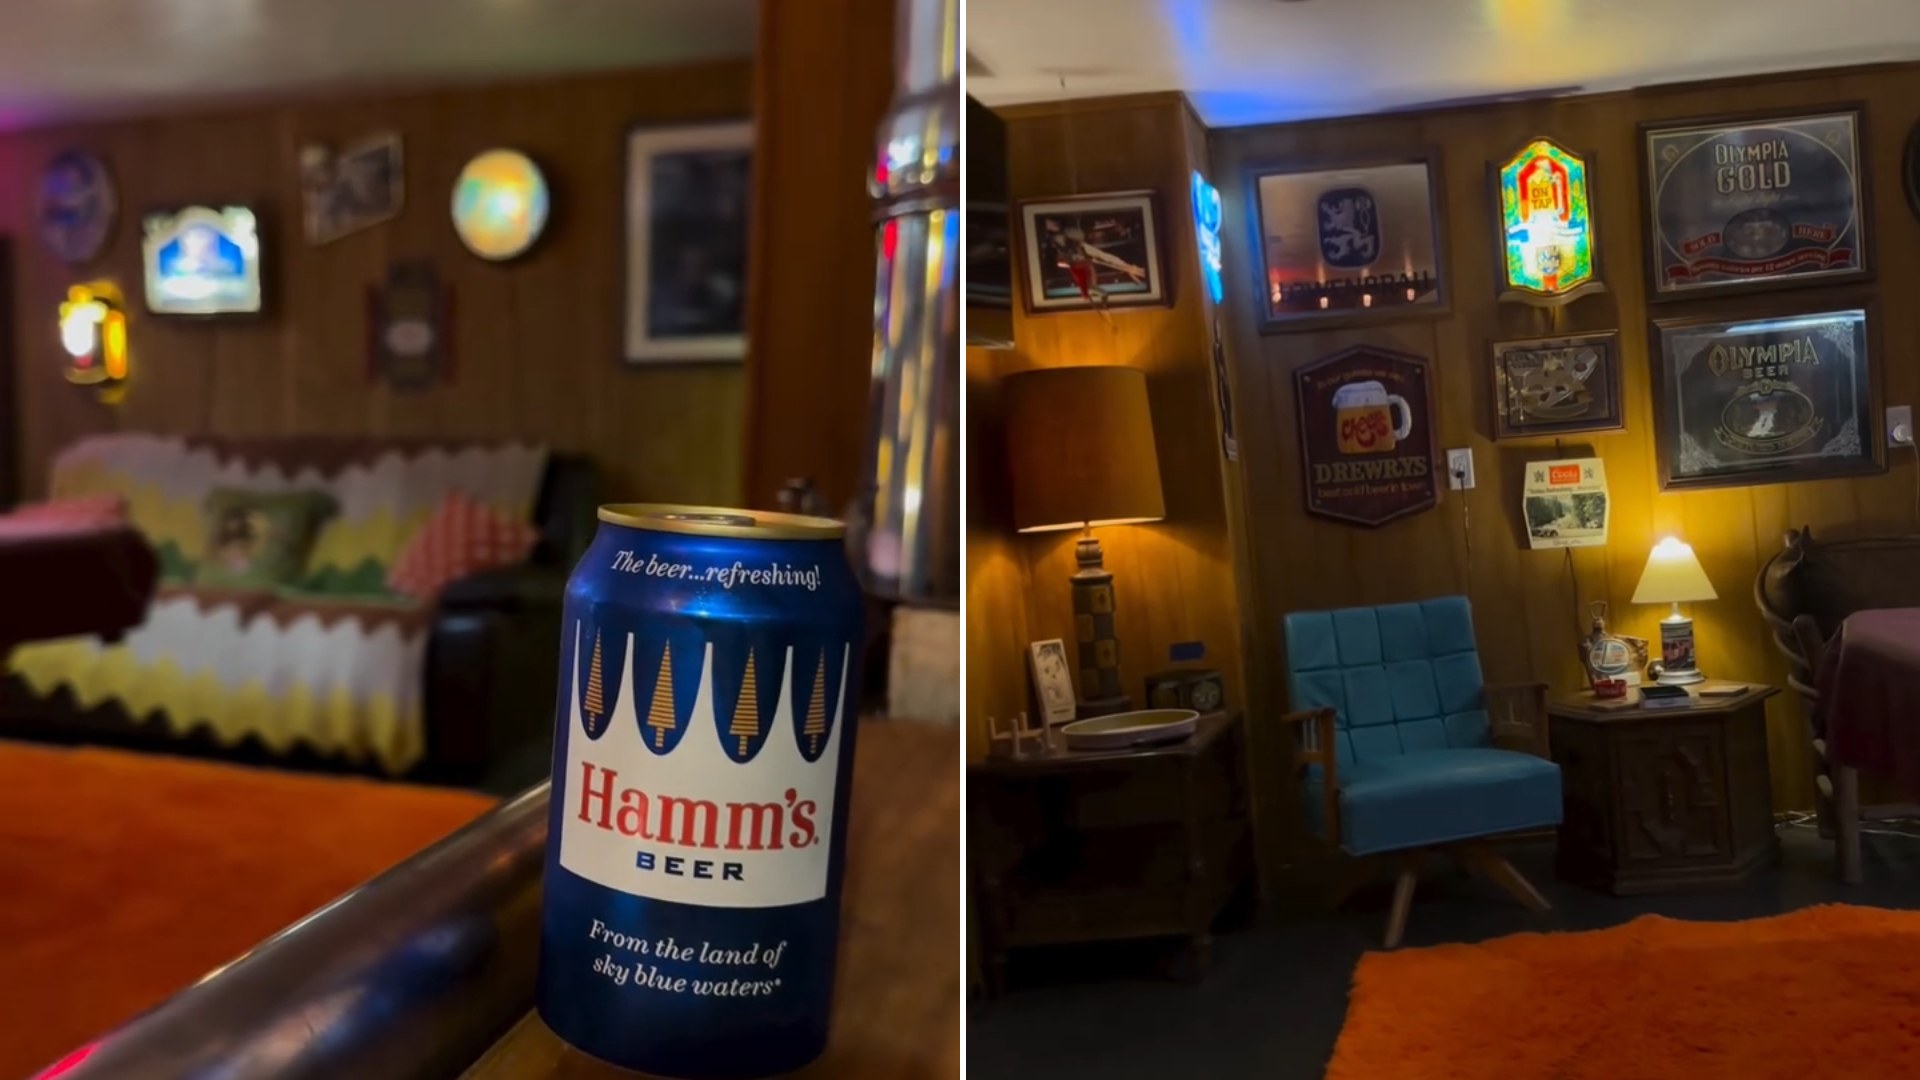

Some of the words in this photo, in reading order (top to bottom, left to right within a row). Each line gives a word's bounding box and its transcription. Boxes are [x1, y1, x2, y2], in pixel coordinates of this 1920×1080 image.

[1714, 140, 1789, 165] OLYMPIA
[1717, 161, 1791, 194] GOLD
[1531, 198, 1552, 210] TAP
[1532, 187, 1549, 198] ON
[1708, 336, 1819, 376] OLYMPIA
[1743, 365, 1789, 379] BEER
[1314, 456, 1427, 484] DREWRYS
[610, 550, 644, 573] The
[578, 761, 817, 851] Hamm's
[636, 851, 745, 881] BEER
[589, 918, 650, 954] From
[655, 937, 695, 962] the
[699, 941, 758, 966] land
[763, 940, 788, 969] of
[592, 954, 630, 986] sky
[634, 963, 688, 993] blue
